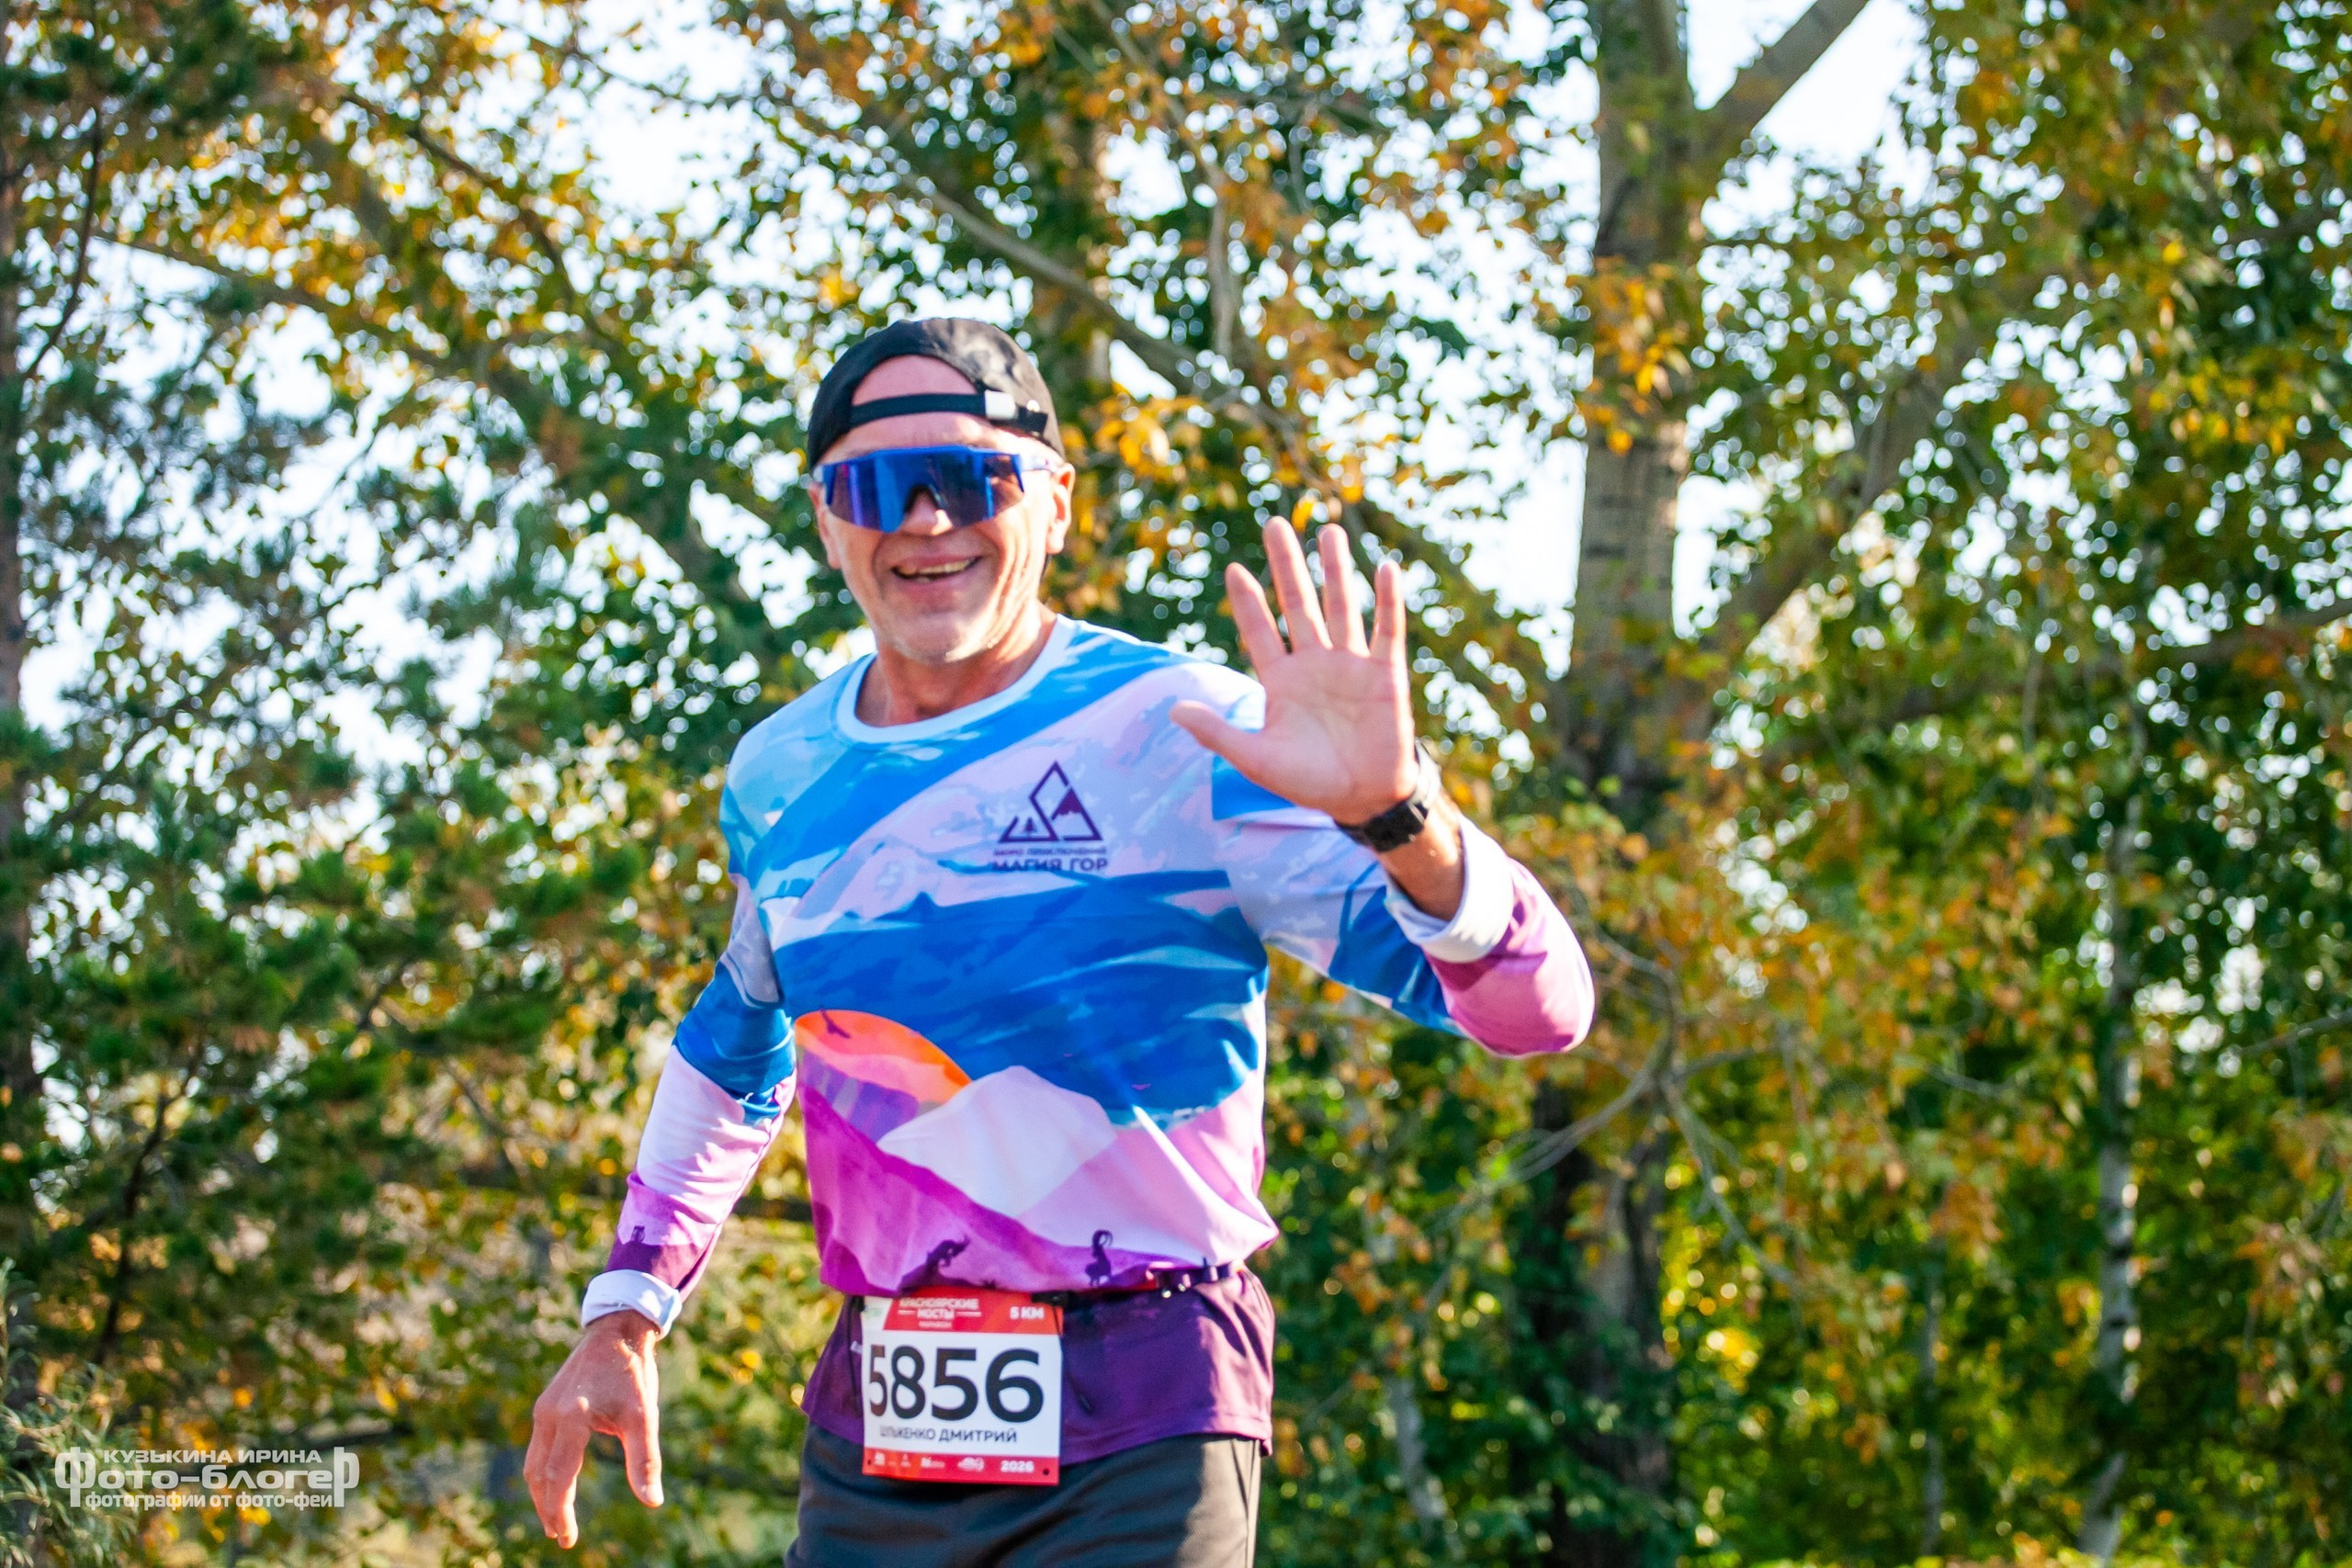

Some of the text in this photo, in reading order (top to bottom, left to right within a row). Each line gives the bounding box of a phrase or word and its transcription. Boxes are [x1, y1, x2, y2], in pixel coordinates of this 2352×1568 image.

[1069, 858, 1108, 872] ГОР
[869, 1344, 1045, 1423] 5856
[938, 1427, 1018, 1443] ДМИТРИЙ
[1001, 1460, 1035, 1472] 2026
